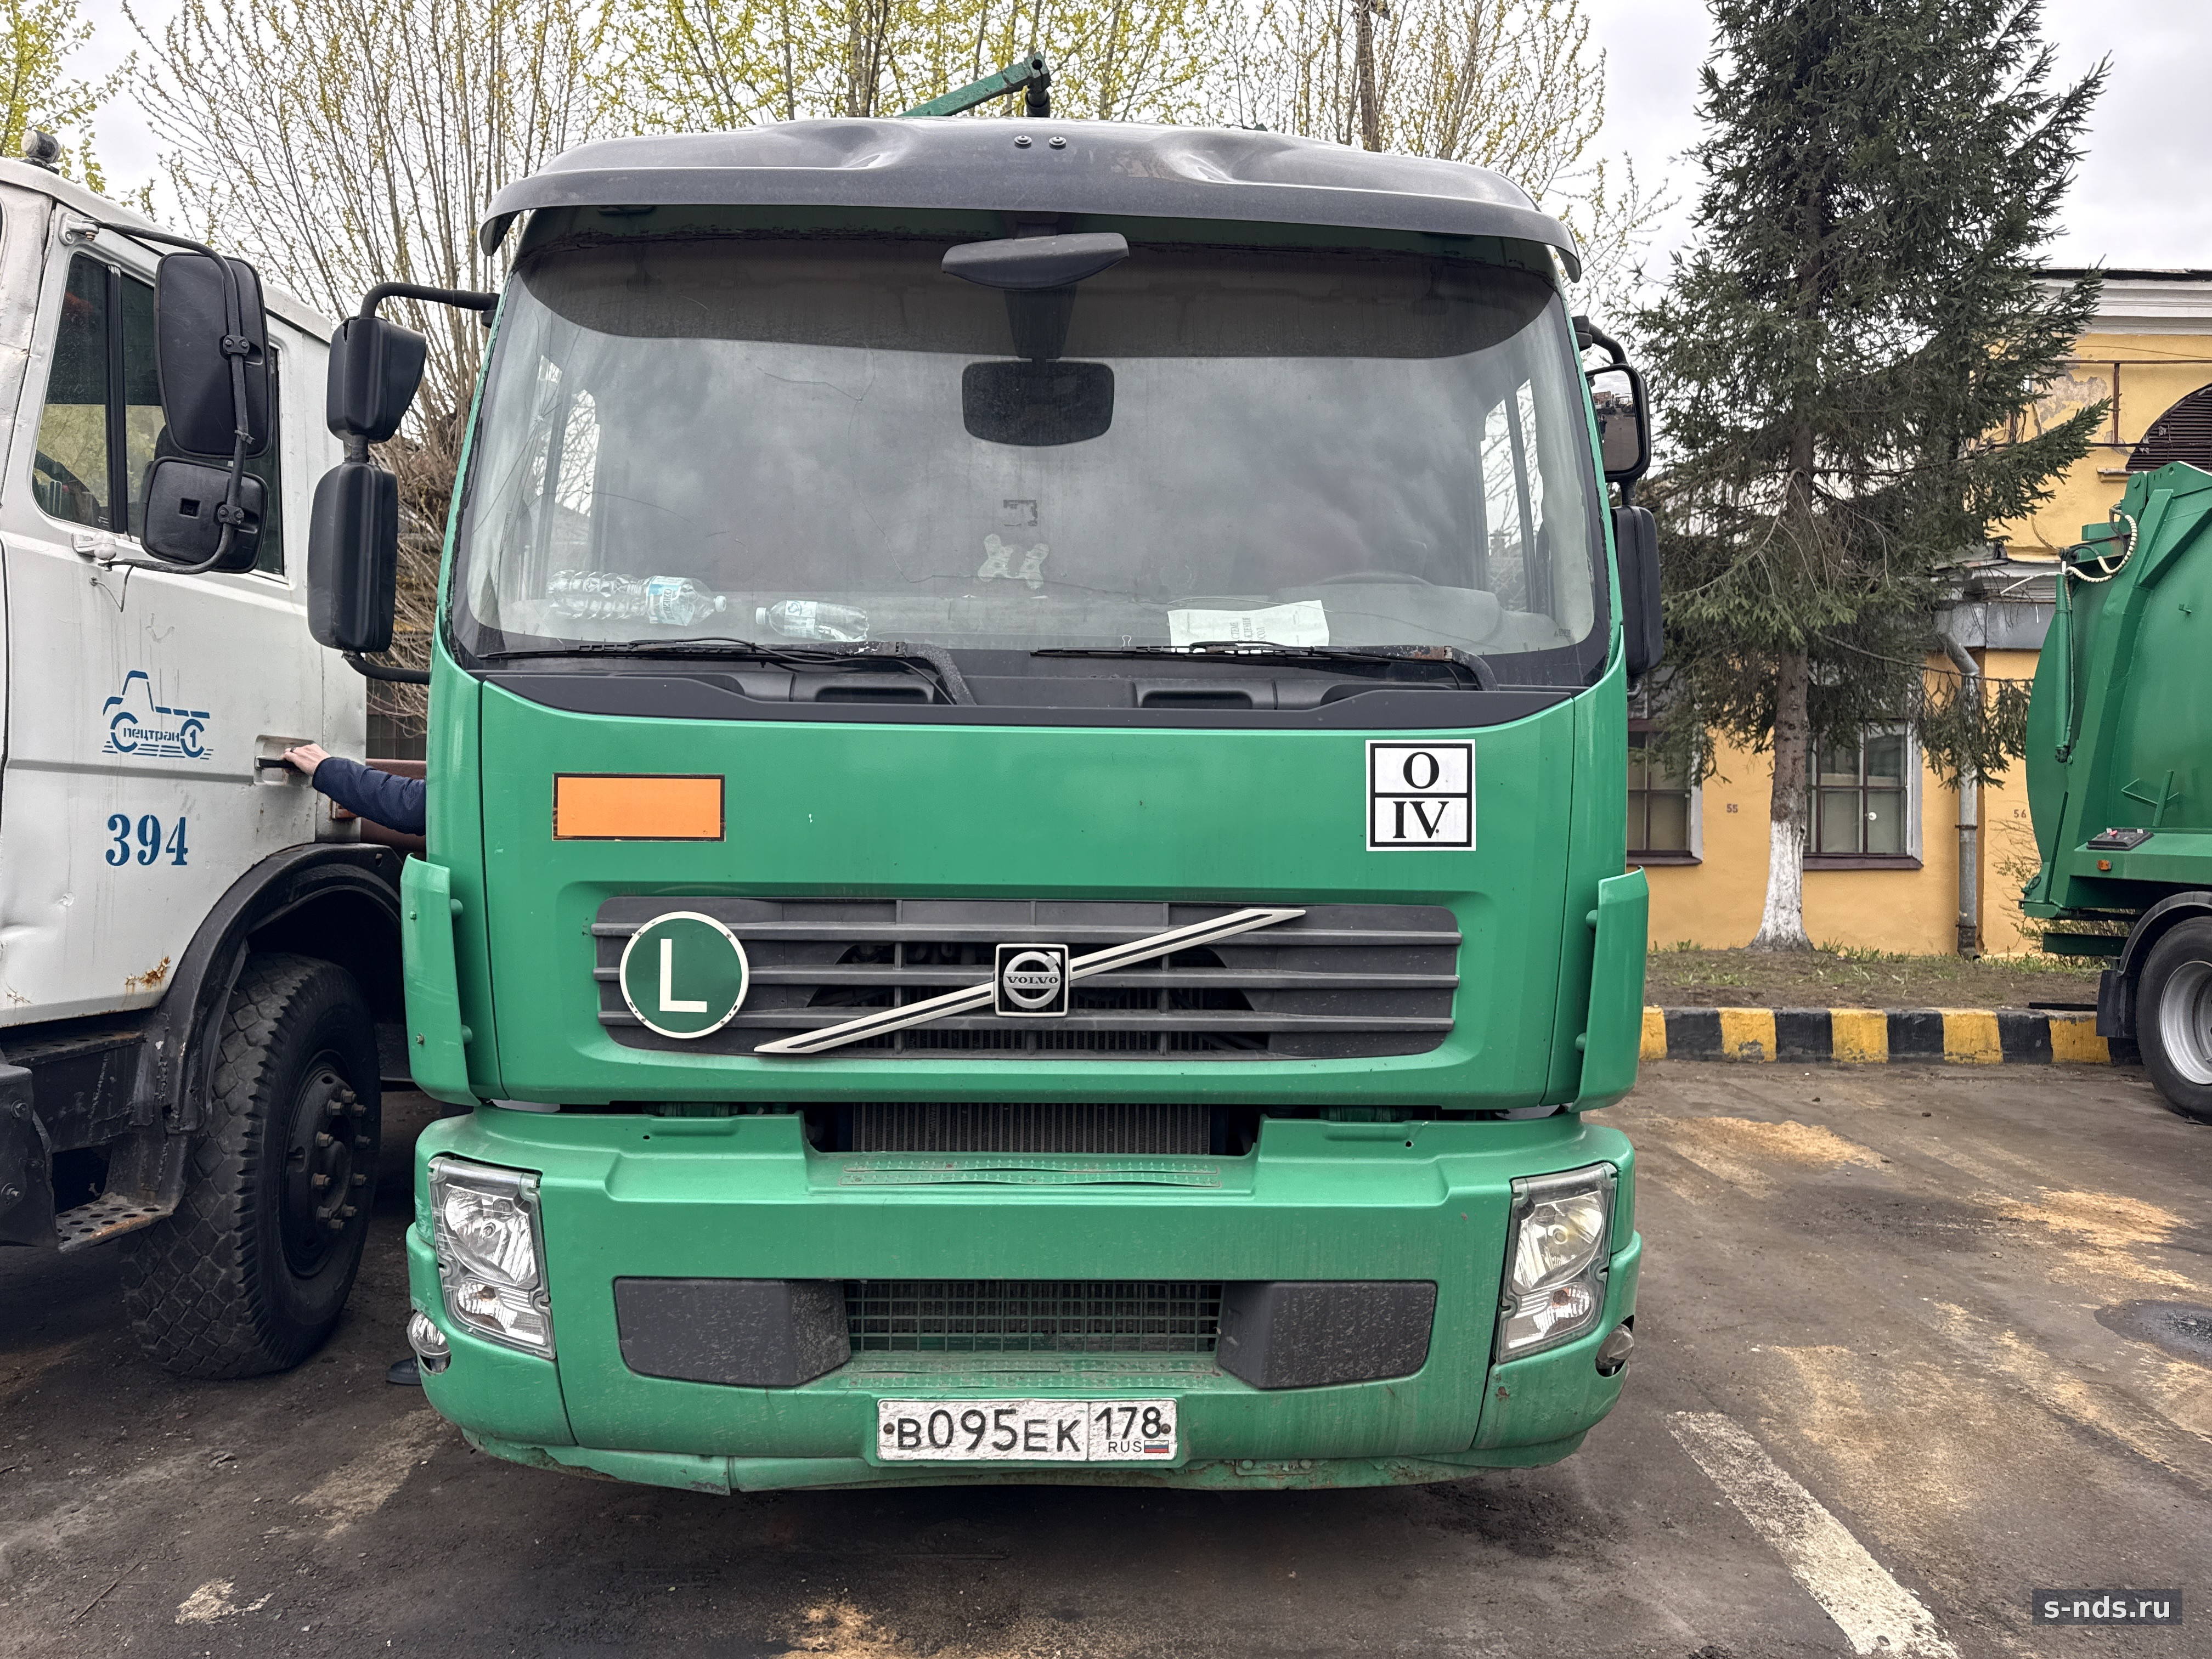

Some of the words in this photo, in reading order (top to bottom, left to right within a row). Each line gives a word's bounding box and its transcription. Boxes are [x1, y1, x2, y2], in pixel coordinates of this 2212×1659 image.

[1230, 622, 1240, 641] СТЕМЕ
[1726, 803, 1738, 813] 55
[2014, 809, 2026, 818] 56
[1392, 800, 1449, 838] IV
[105, 814, 188, 866] 394
[659, 939, 707, 1013] L
[1006, 976, 1058, 984] VOLVO
[897, 1409, 1081, 1452] В095ЕК
[1094, 1406, 1161, 1440] 178
[1108, 1441, 1142, 1453] RUS
